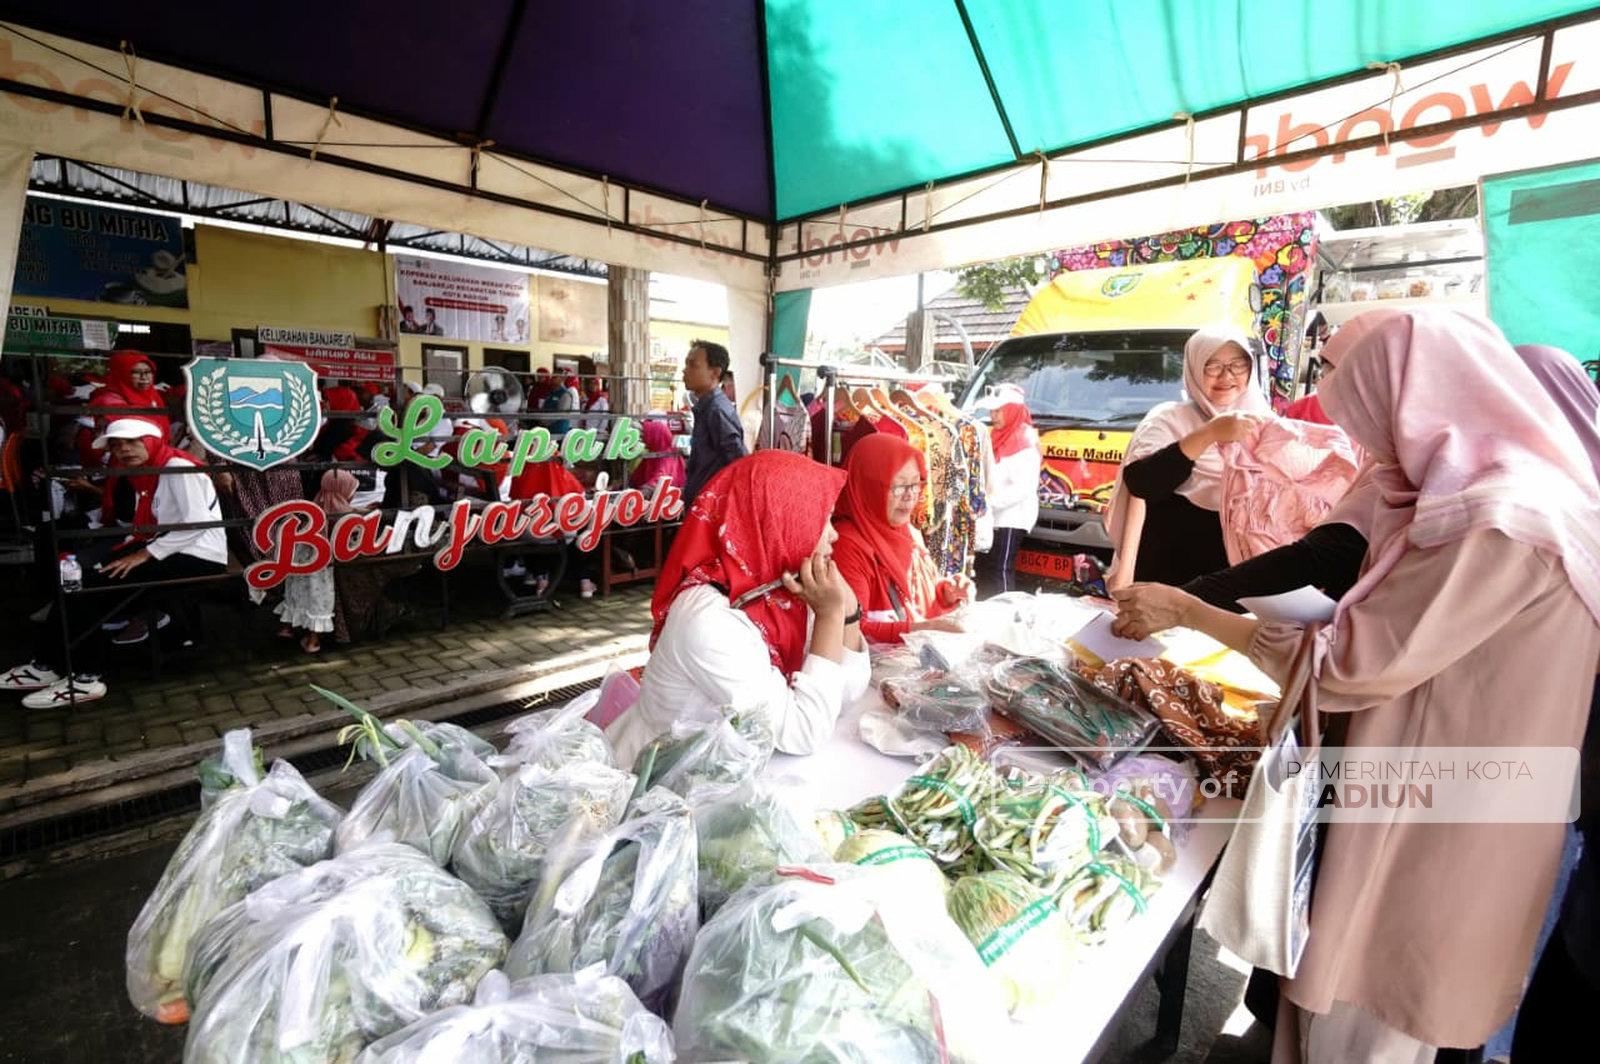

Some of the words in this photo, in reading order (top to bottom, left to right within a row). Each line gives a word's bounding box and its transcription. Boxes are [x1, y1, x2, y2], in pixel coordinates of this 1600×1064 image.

[60, 206, 93, 233] BU
[101, 213, 170, 243] MITHA
[9, 305, 45, 317] AREJO
[34, 319, 82, 335] MITHA
[260, 327, 309, 344] KELURAHAN
[309, 331, 352, 347] BANJAREJO
[371, 395, 646, 477] Lapak
[1046, 445, 1078, 457] Kota
